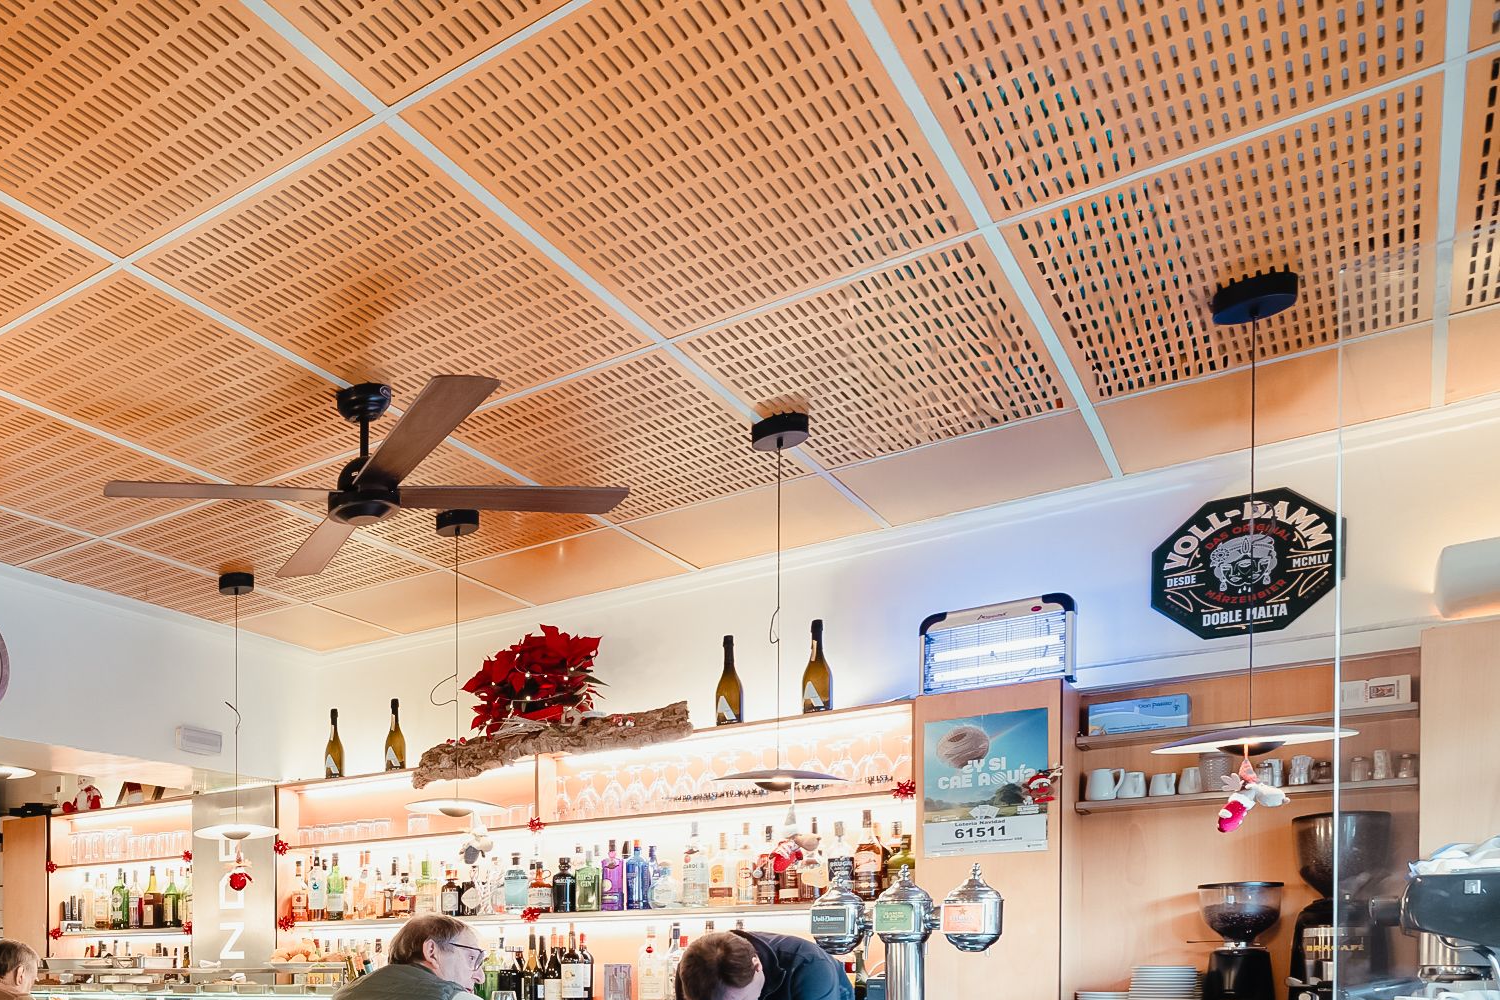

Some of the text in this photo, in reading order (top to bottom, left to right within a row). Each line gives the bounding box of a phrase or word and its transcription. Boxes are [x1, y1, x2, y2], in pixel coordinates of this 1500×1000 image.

[1163, 500, 1333, 571] VOLL-DAMM
[1205, 531, 1229, 550] DAS
[1292, 553, 1330, 568] MCMLV
[1166, 574, 1197, 588] DESDE
[1202, 603, 1288, 627] DOBLE MALTA
[962, 757, 1006, 774] ¿Y SI
[938, 774, 972, 789] CAE
[954, 826, 1006, 839] 61511
